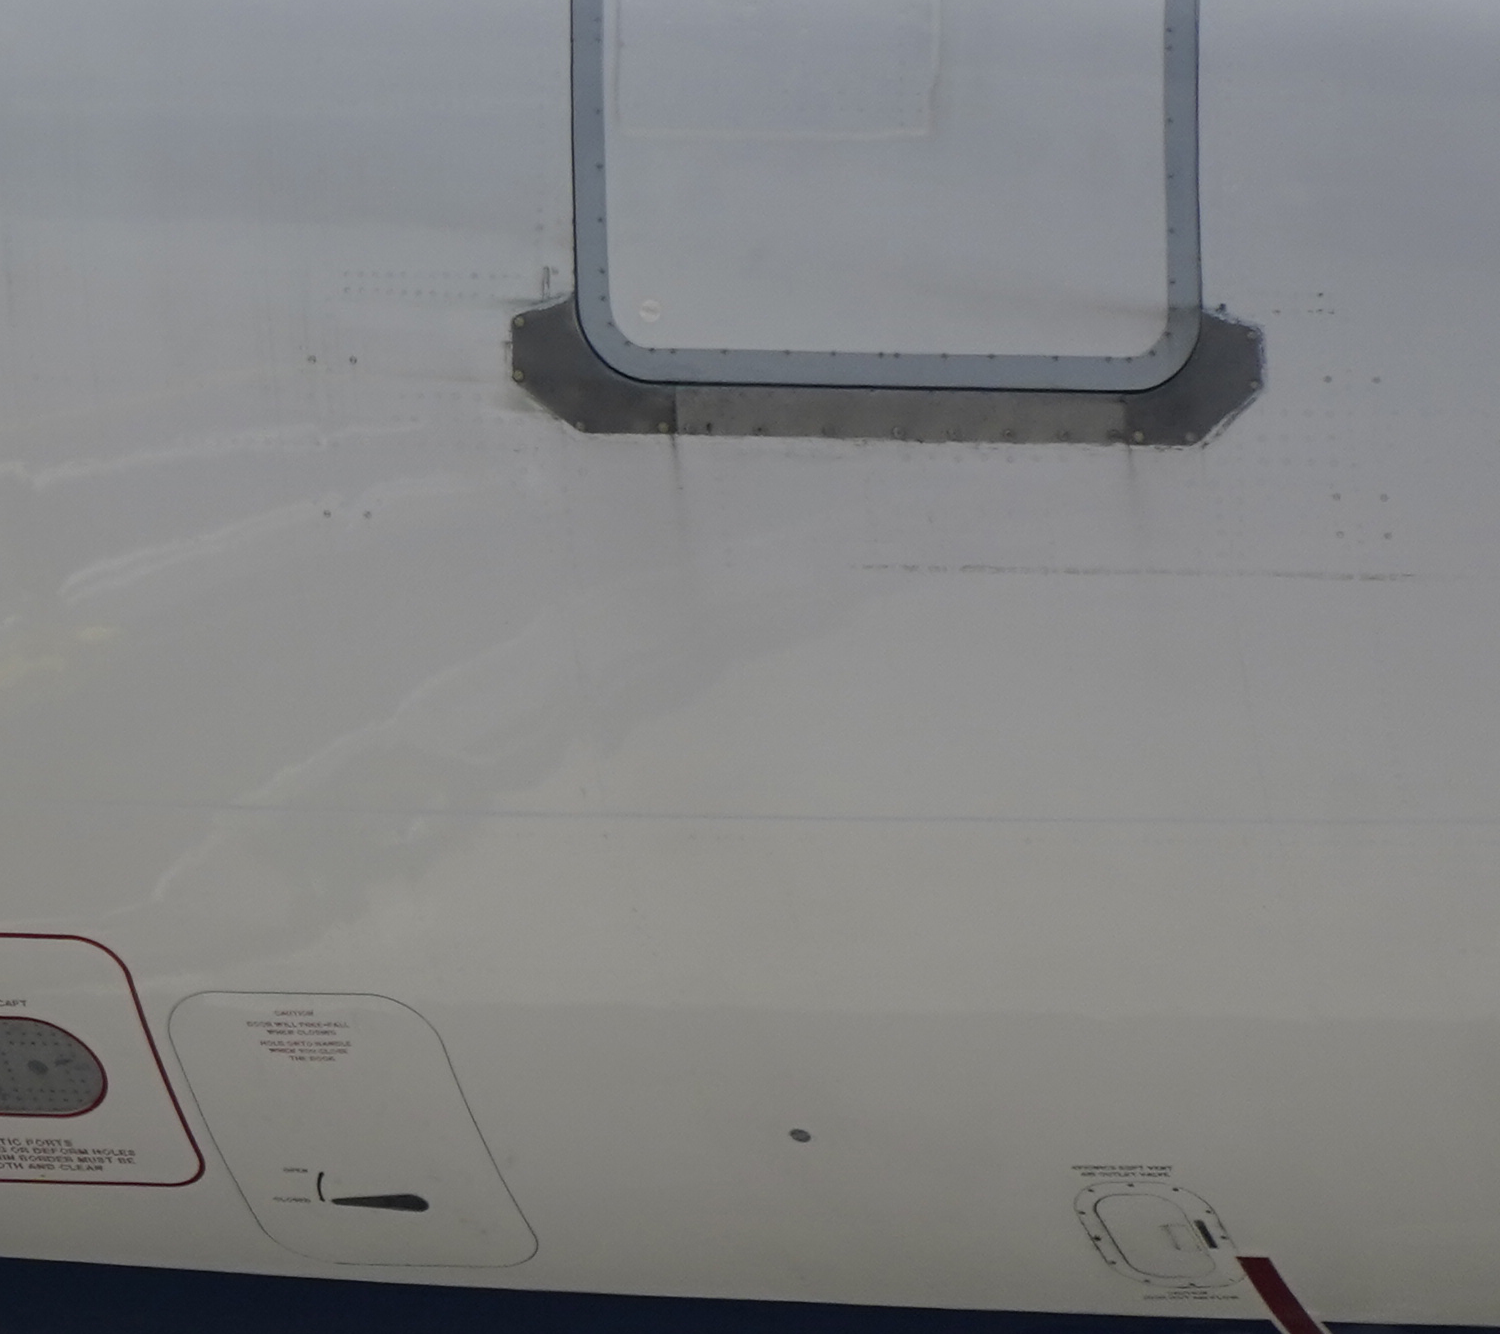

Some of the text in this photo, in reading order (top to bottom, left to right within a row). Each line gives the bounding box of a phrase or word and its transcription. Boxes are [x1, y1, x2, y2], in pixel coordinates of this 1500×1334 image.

[25, 1139, 72, 1147] PORTS
[10, 1146, 29, 1154] OR
[33, 1147, 88, 1155] DEFORM
[92, 1148, 136, 1156] HOLES
[18, 1154, 72, 1163] BORDER
[77, 1156, 112, 1164] MUST
[28, 1162, 55, 1170] AND
